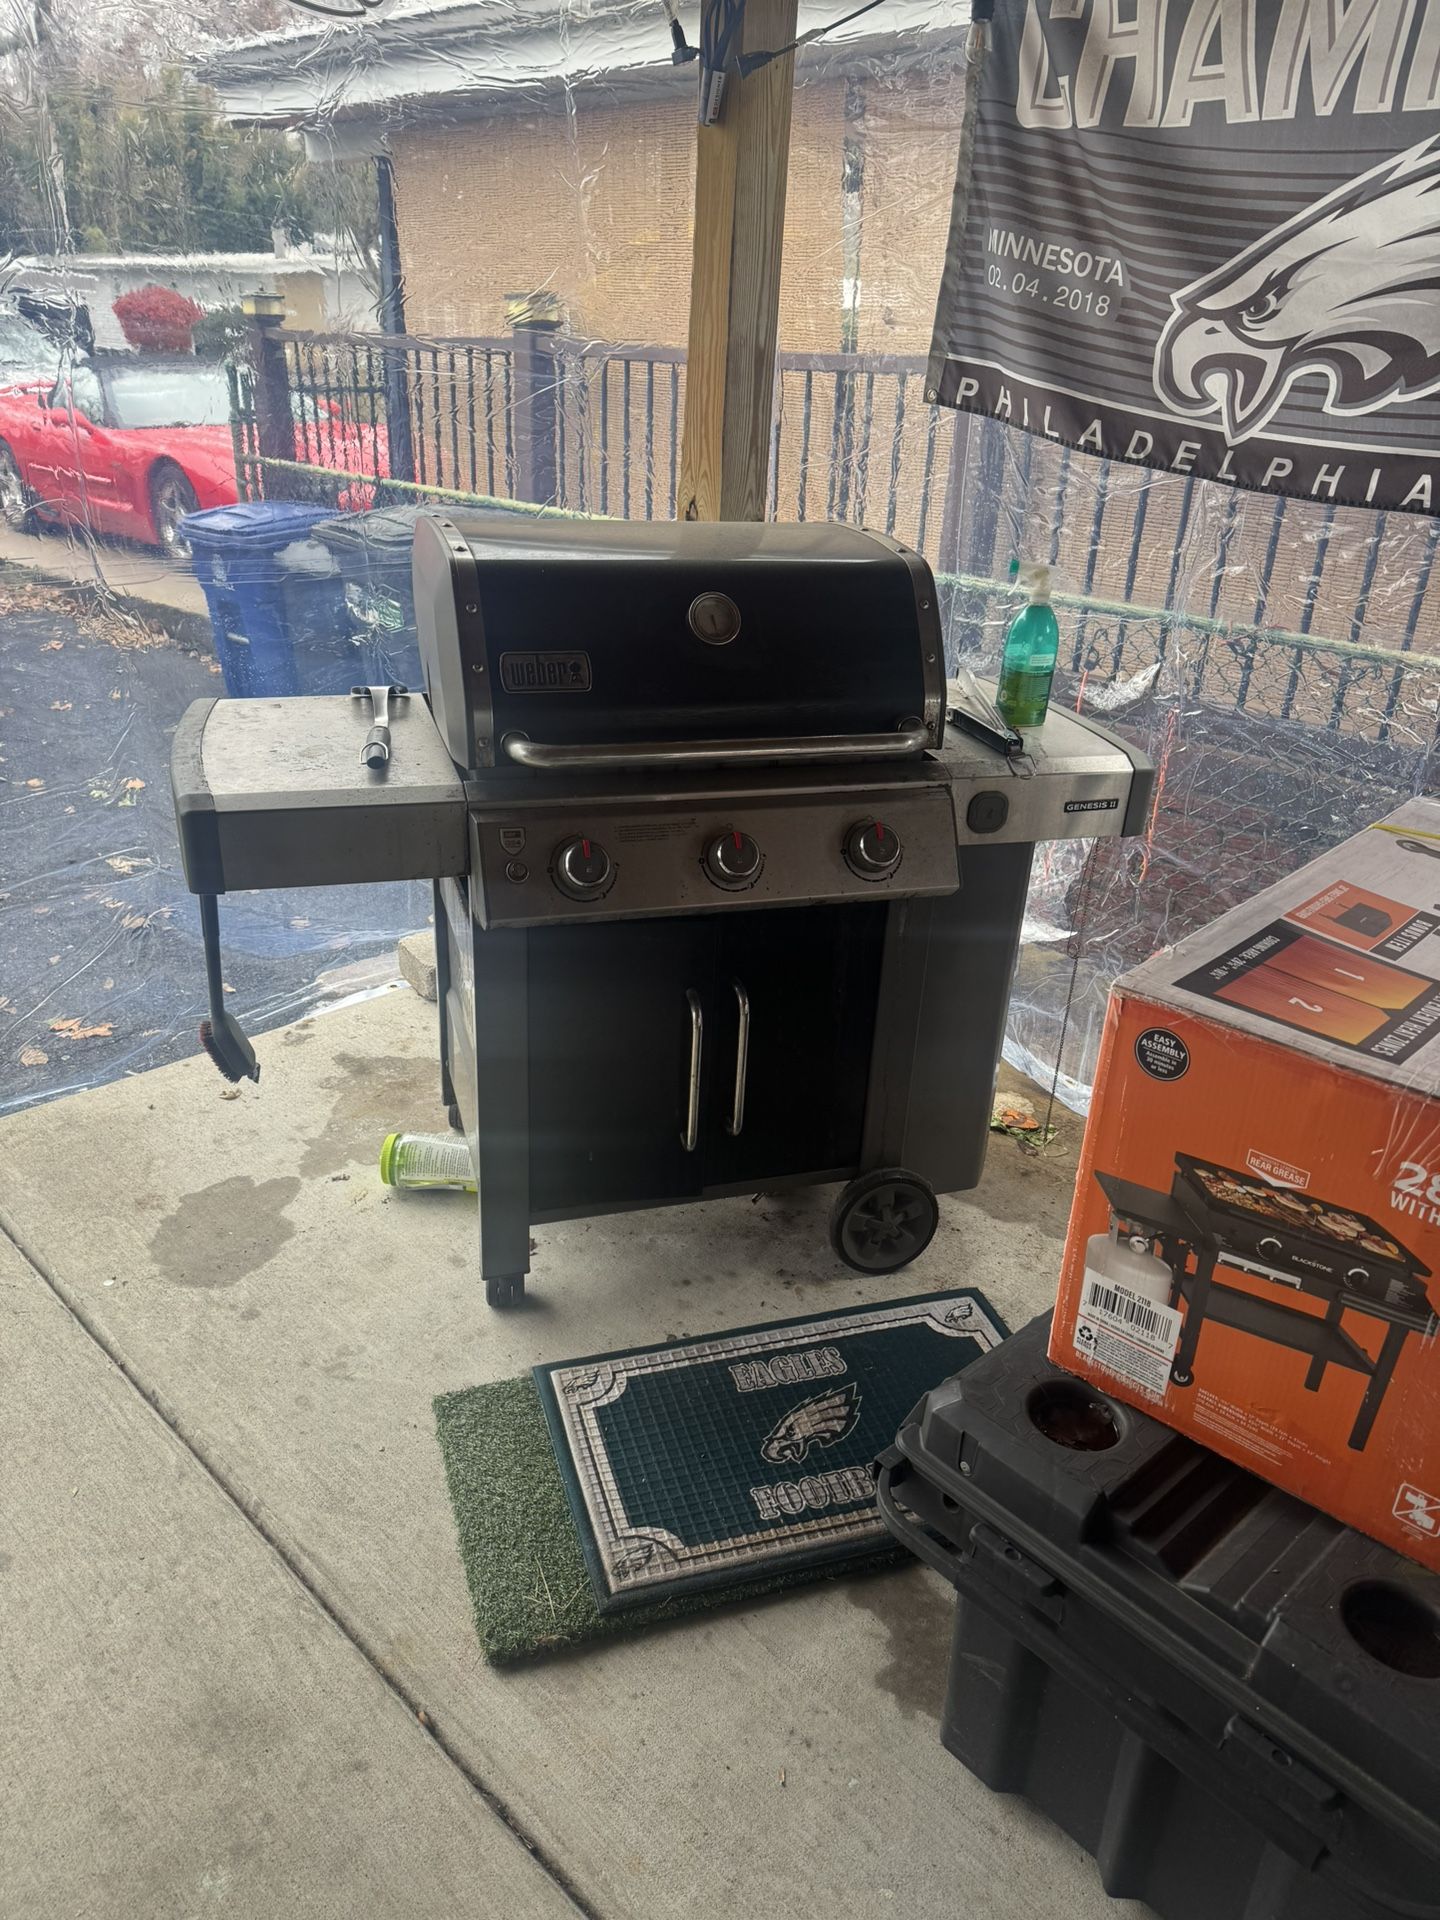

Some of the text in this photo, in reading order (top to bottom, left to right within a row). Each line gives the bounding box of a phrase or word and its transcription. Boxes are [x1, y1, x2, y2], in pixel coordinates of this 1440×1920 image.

[988, 228, 1124, 287] MINNESOTA
[956, 377, 1433, 508] PHILADELPHIA
[510, 655, 567, 686] weber
[1066, 800, 1117, 811] GENESIS II
[1385, 919, 1433, 952] BONUS ITEM
[1334, 967, 1365, 981] 1
[1288, 996, 1324, 1013] 2
[1154, 1033, 1176, 1048] EASY
[1392, 1020, 1427, 1040] HEAT
[1141, 1038, 1186, 1060] ASSEMBLY
[1370, 1034, 1411, 1057] ZONES
[1250, 1156, 1272, 1173] REAR
[1272, 1165, 1306, 1187] GREASE
[1391, 1189, 1440, 1227] WITH
[1291, 1254, 1335, 1274] BLACKSTONE
[1114, 1283, 1152, 1308] MODEL 2118
[1082, 1299, 1088, 1307] 7
[1130, 1324, 1156, 1342] 02118
[1167, 1342, 1174, 1350] 7
[728, 1346, 848, 1393] EAGLES
[750, 1462, 877, 1520] FOOTB
